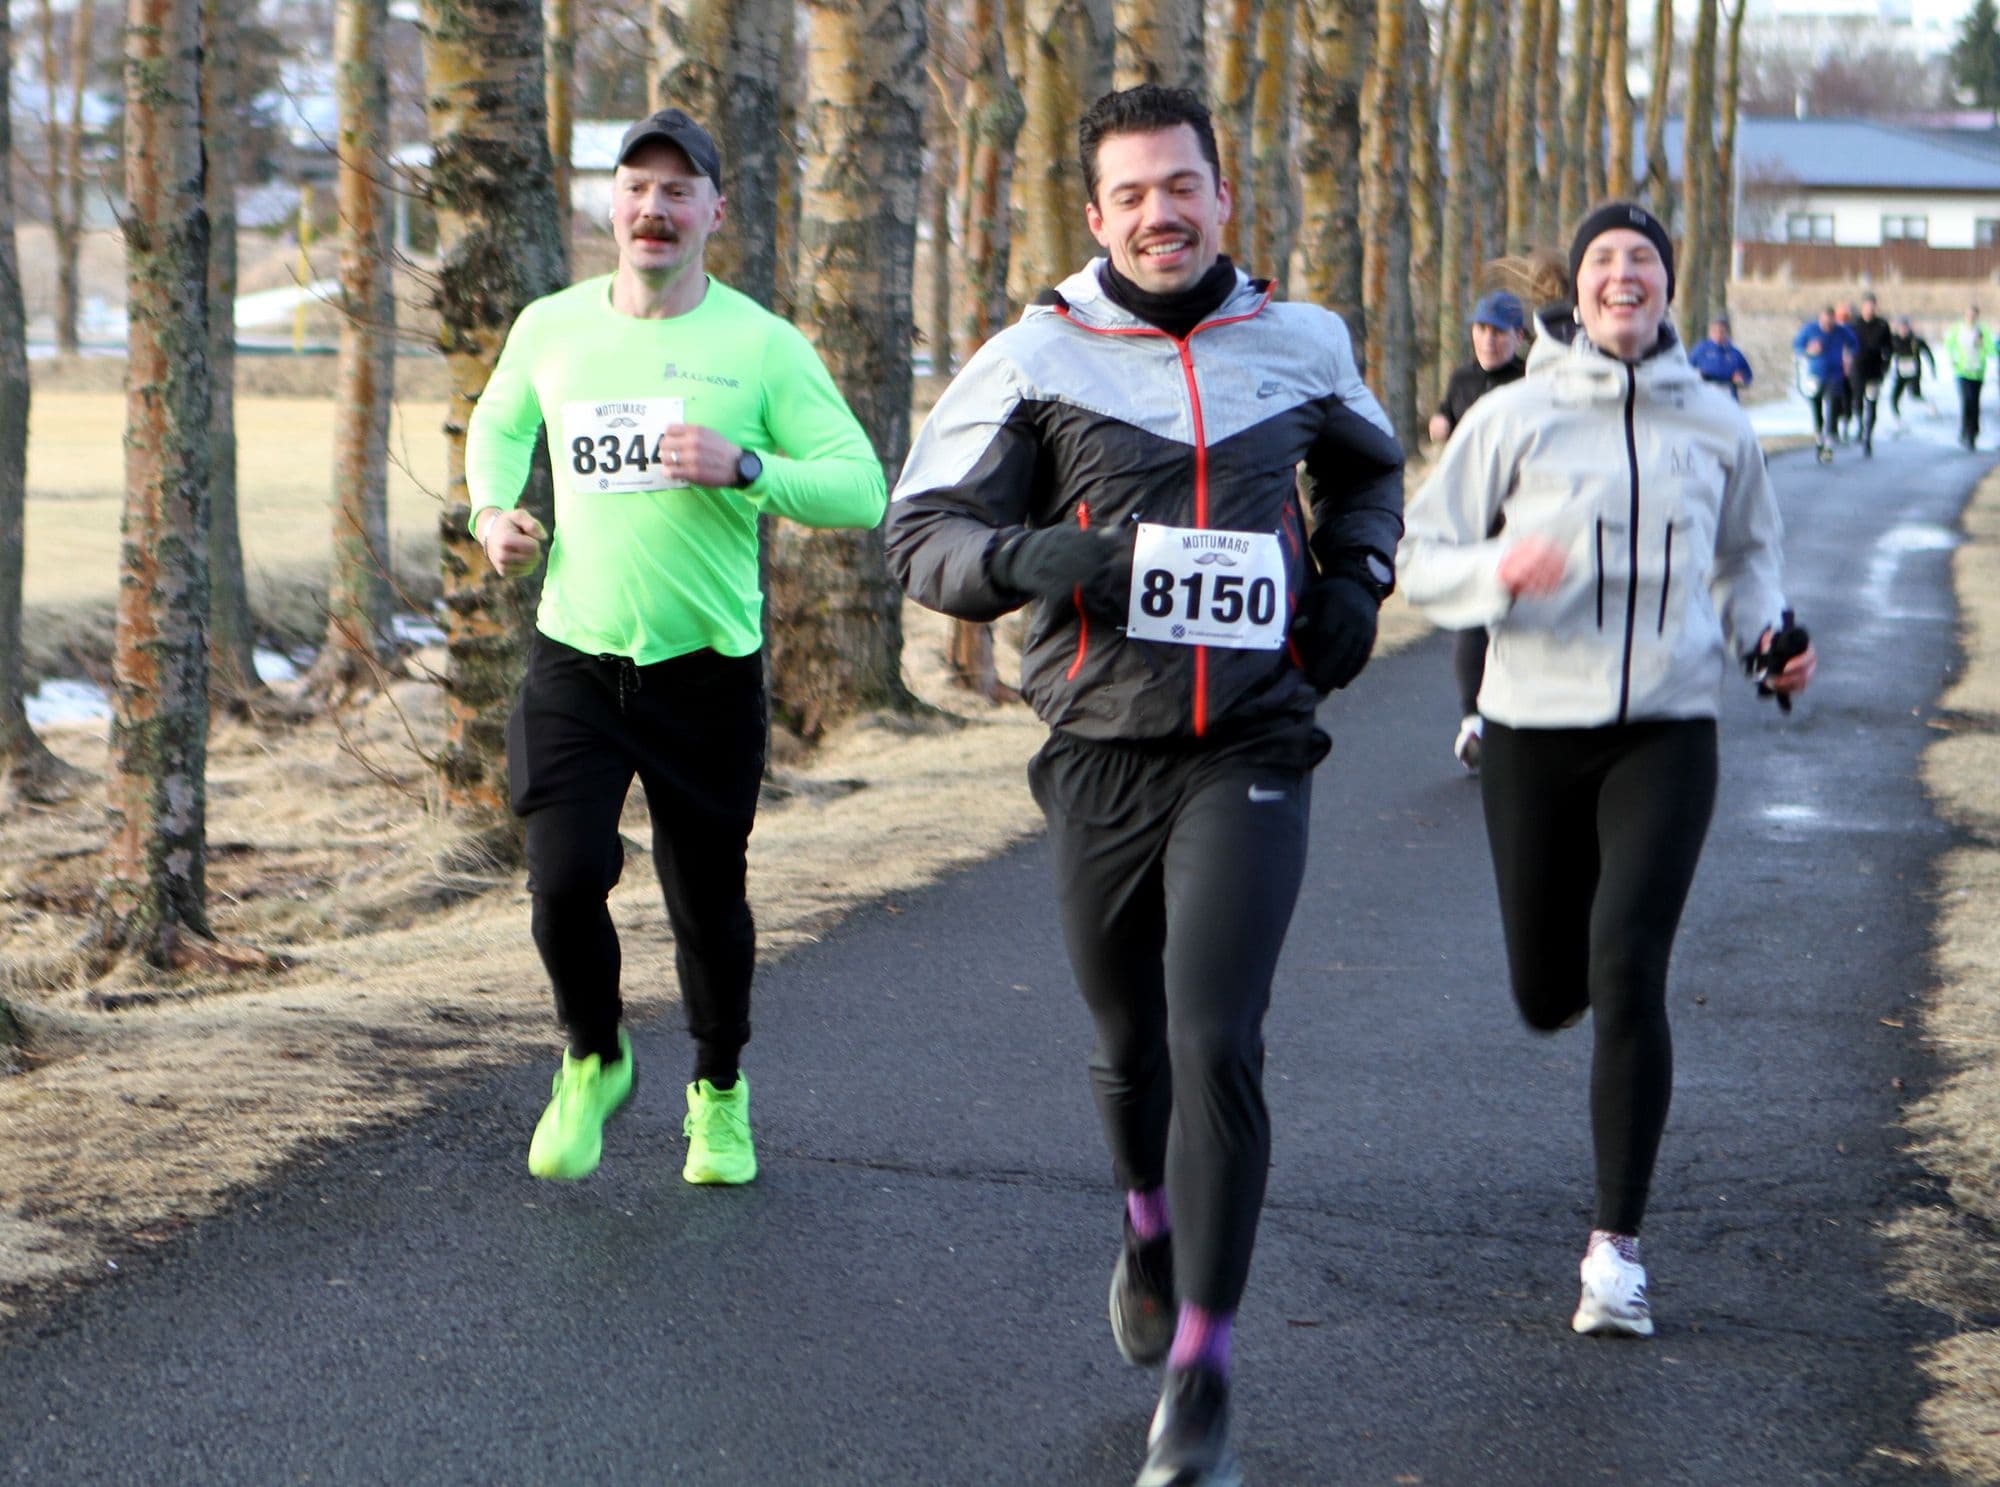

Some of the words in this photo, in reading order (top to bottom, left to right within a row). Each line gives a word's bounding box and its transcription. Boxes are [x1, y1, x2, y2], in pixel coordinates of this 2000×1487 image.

[595, 403, 647, 417] MOTTUMARS
[1182, 535, 1250, 554] MOTTUMARS
[1140, 568, 1276, 626] 8150
